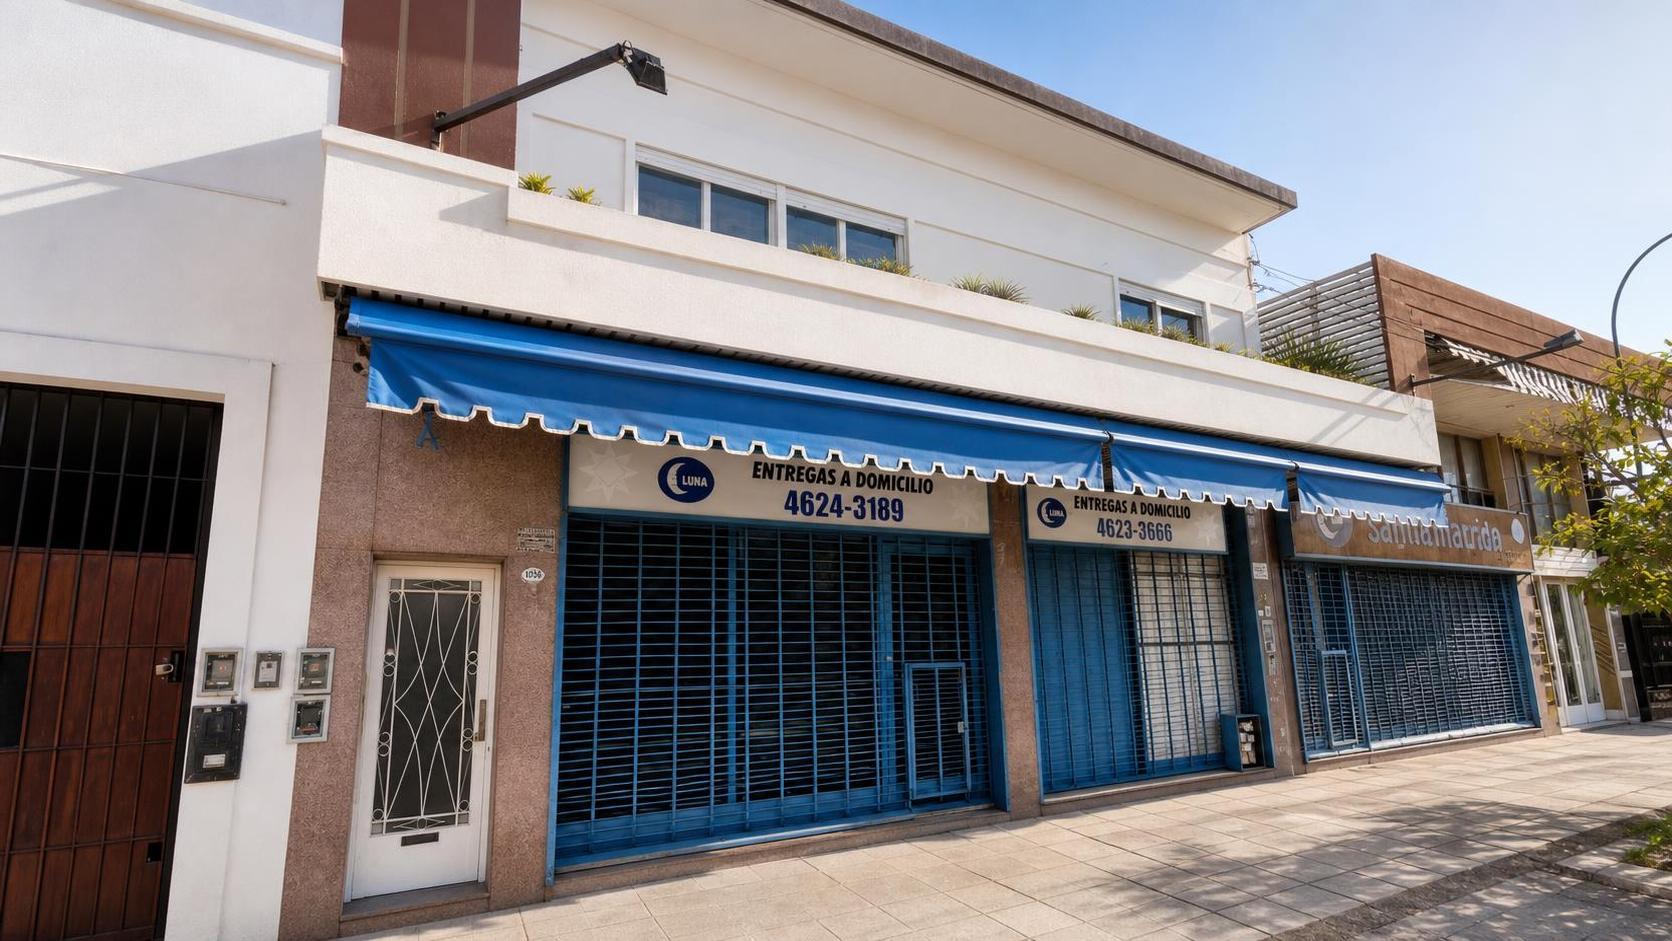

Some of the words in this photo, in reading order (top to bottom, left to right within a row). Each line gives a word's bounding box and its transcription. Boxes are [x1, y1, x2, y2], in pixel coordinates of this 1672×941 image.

[682, 475, 708, 488] LUNA
[752, 461, 836, 486] ENTREGAS
[840, 471, 851, 487] A
[856, 472, 934, 495] DOMICILIO
[784, 490, 904, 522] 4624-3189
[1074, 496, 1127, 514] ENTREGAS
[1130, 502, 1138, 514] A
[1140, 502, 1191, 519] DOMICILIO
[1097, 518, 1173, 542] 4623-3666
